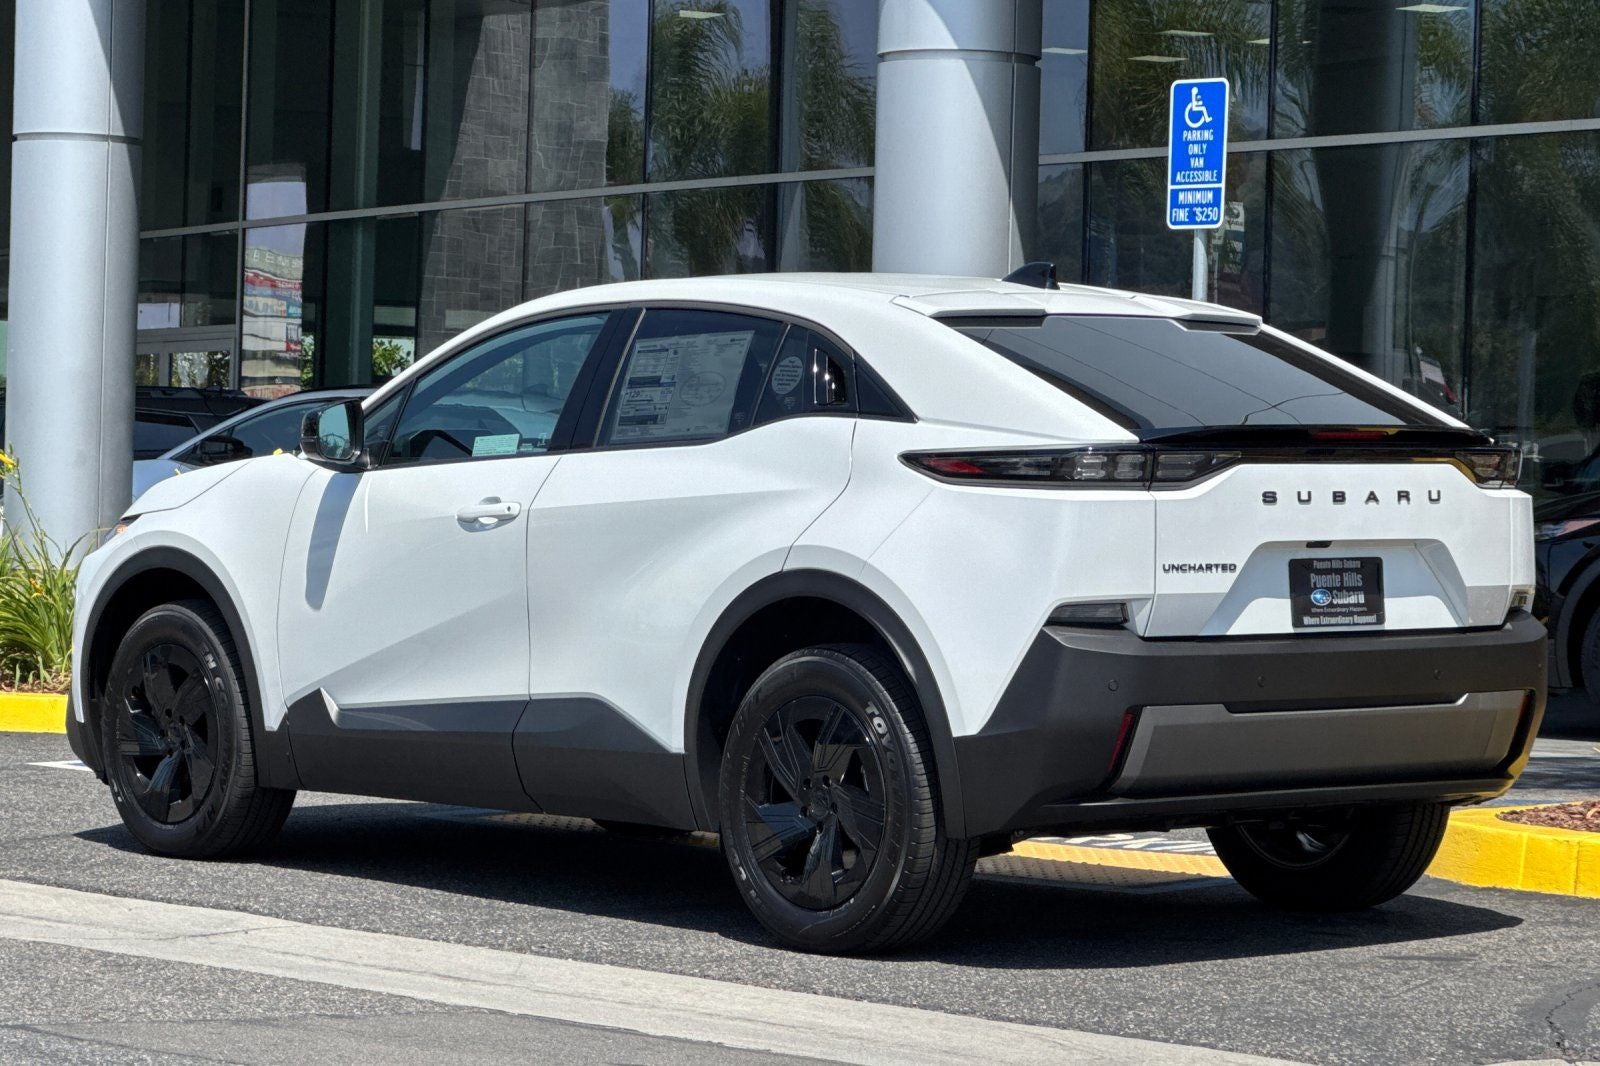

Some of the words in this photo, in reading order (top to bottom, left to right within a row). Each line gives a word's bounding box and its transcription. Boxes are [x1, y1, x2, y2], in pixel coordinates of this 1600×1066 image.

[1182, 129, 1214, 141] PARKING
[1187, 143, 1208, 155] ONLY
[1189, 157, 1204, 168] VAN
[1175, 170, 1218, 183] ACCESSIBLE
[1178, 190, 1213, 205] MINIMUM
[1171, 208, 1190, 222] FINE
[1261, 489, 1441, 506] SUBARU
[1162, 563, 1237, 574] UNCHARTED
[1310, 572, 1341, 588] Puente
[1343, 571, 1363, 587] Hills
[1332, 590, 1365, 605] Subaru
